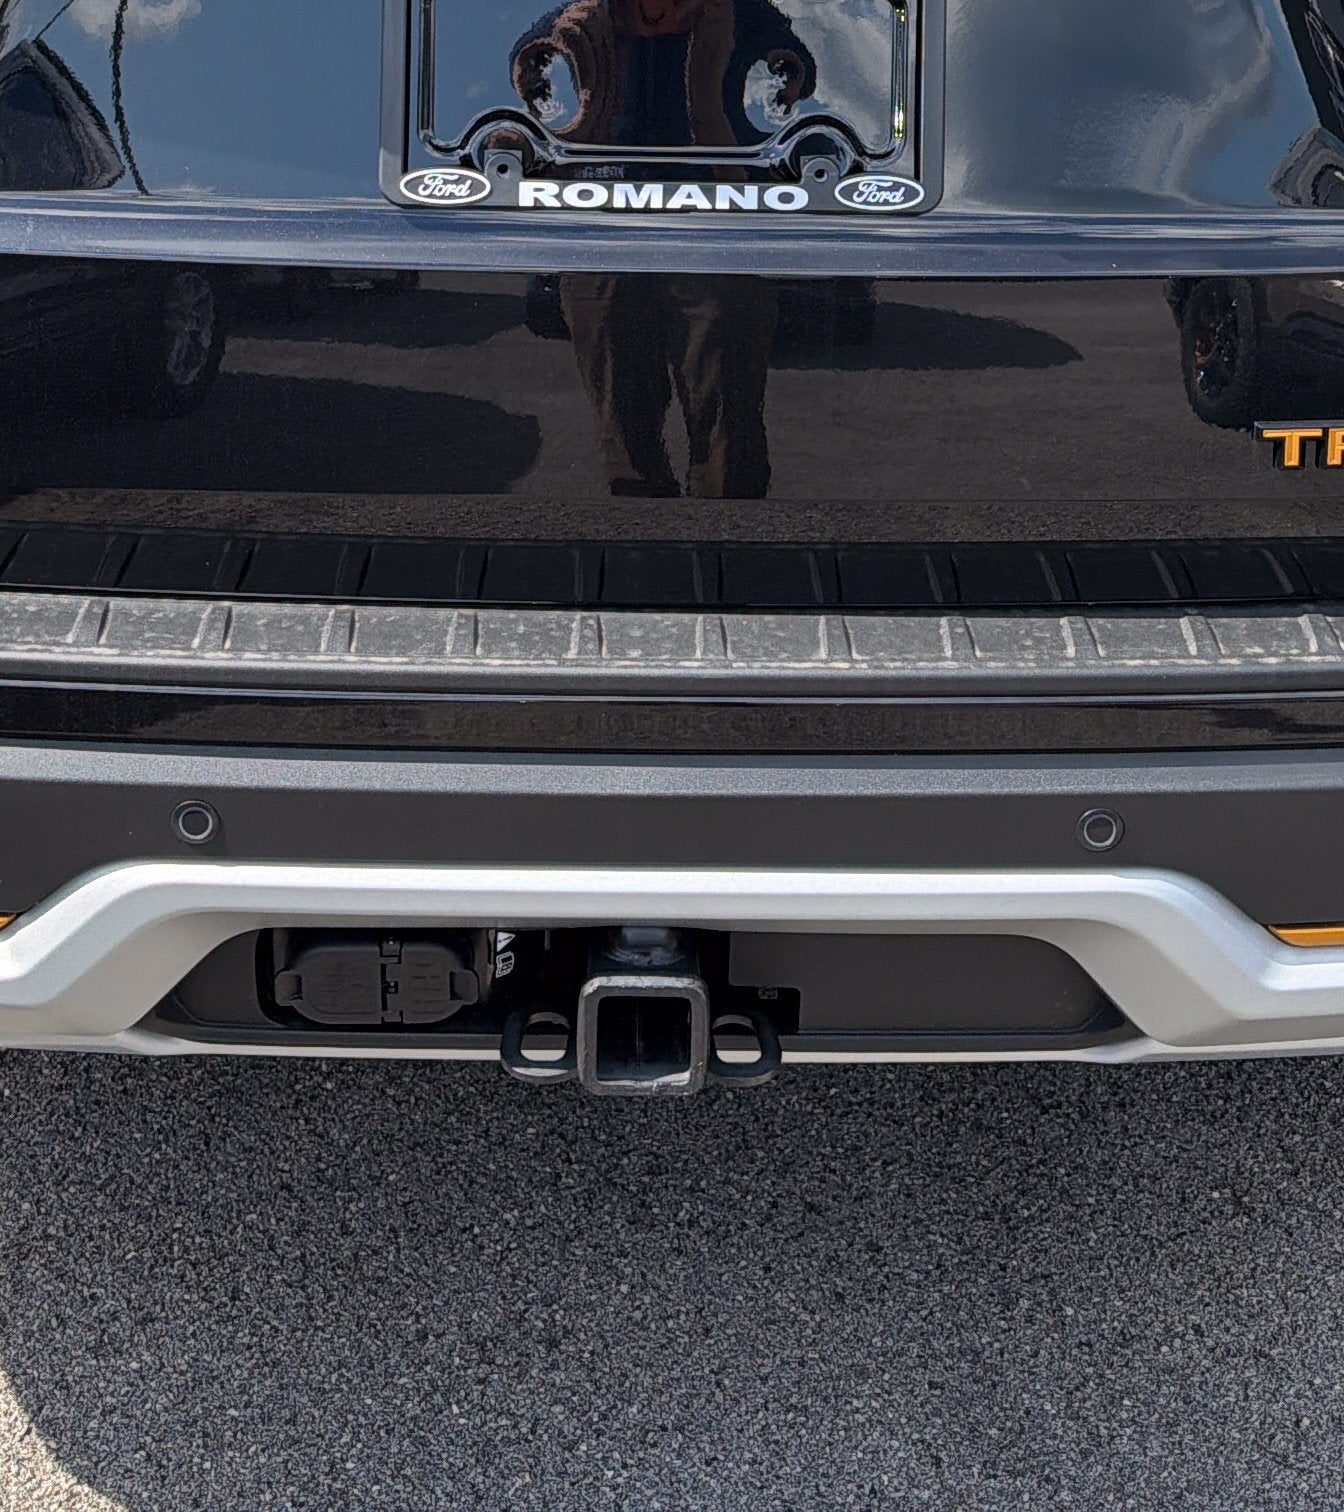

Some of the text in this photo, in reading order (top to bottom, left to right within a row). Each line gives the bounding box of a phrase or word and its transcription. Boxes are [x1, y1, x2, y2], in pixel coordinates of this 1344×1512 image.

[417, 171, 906, 211] Ford ROMANO Ford
